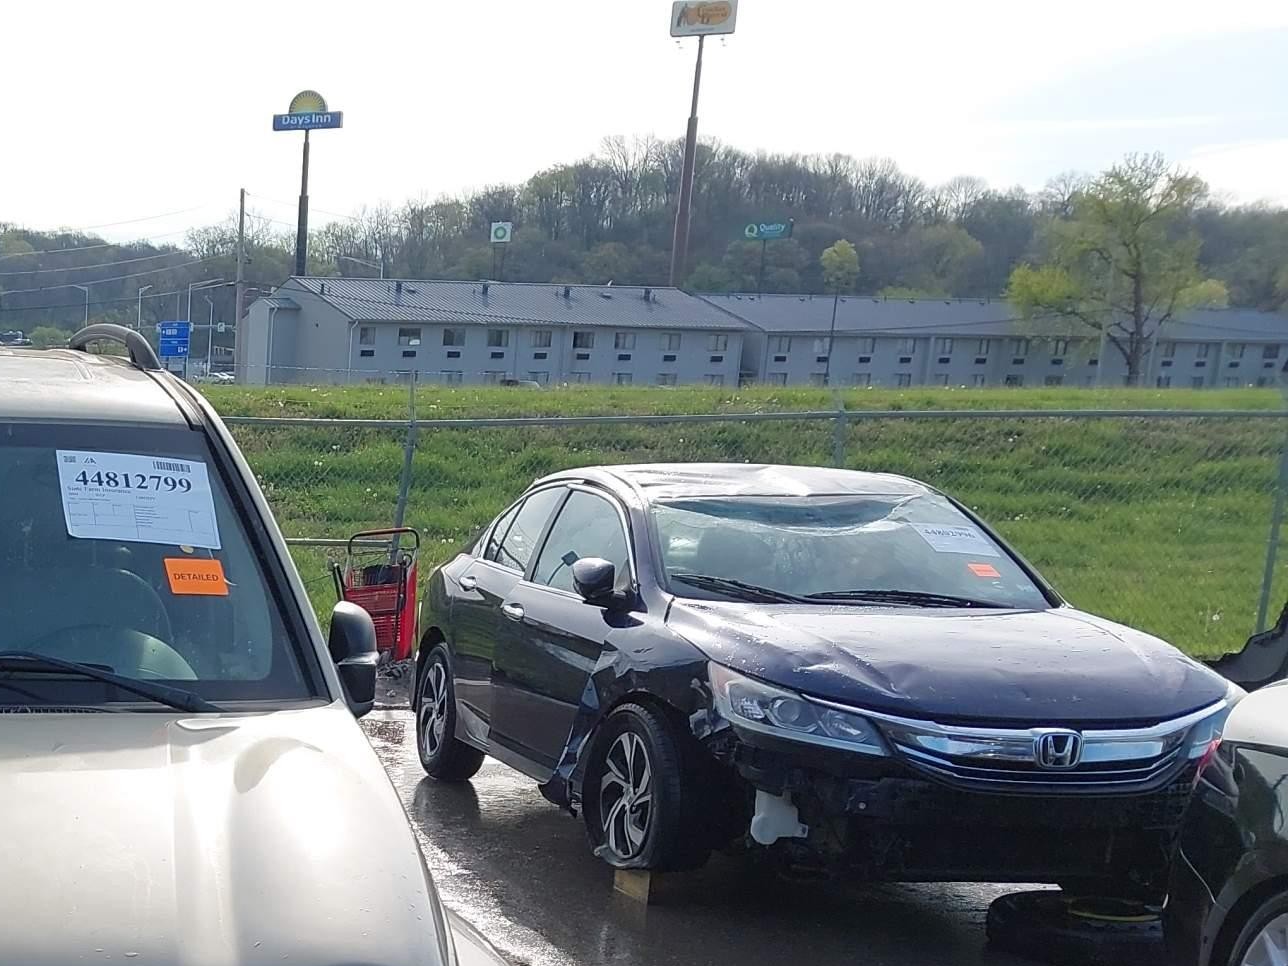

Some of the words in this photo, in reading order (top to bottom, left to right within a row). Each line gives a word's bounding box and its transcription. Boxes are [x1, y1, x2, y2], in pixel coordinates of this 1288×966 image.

[282, 115, 310, 127] Days
[312, 113, 331, 123] Inn
[759, 223, 785, 233] Quality
[75, 469, 192, 494] 44812799
[173, 572, 219, 582] DETAILED
